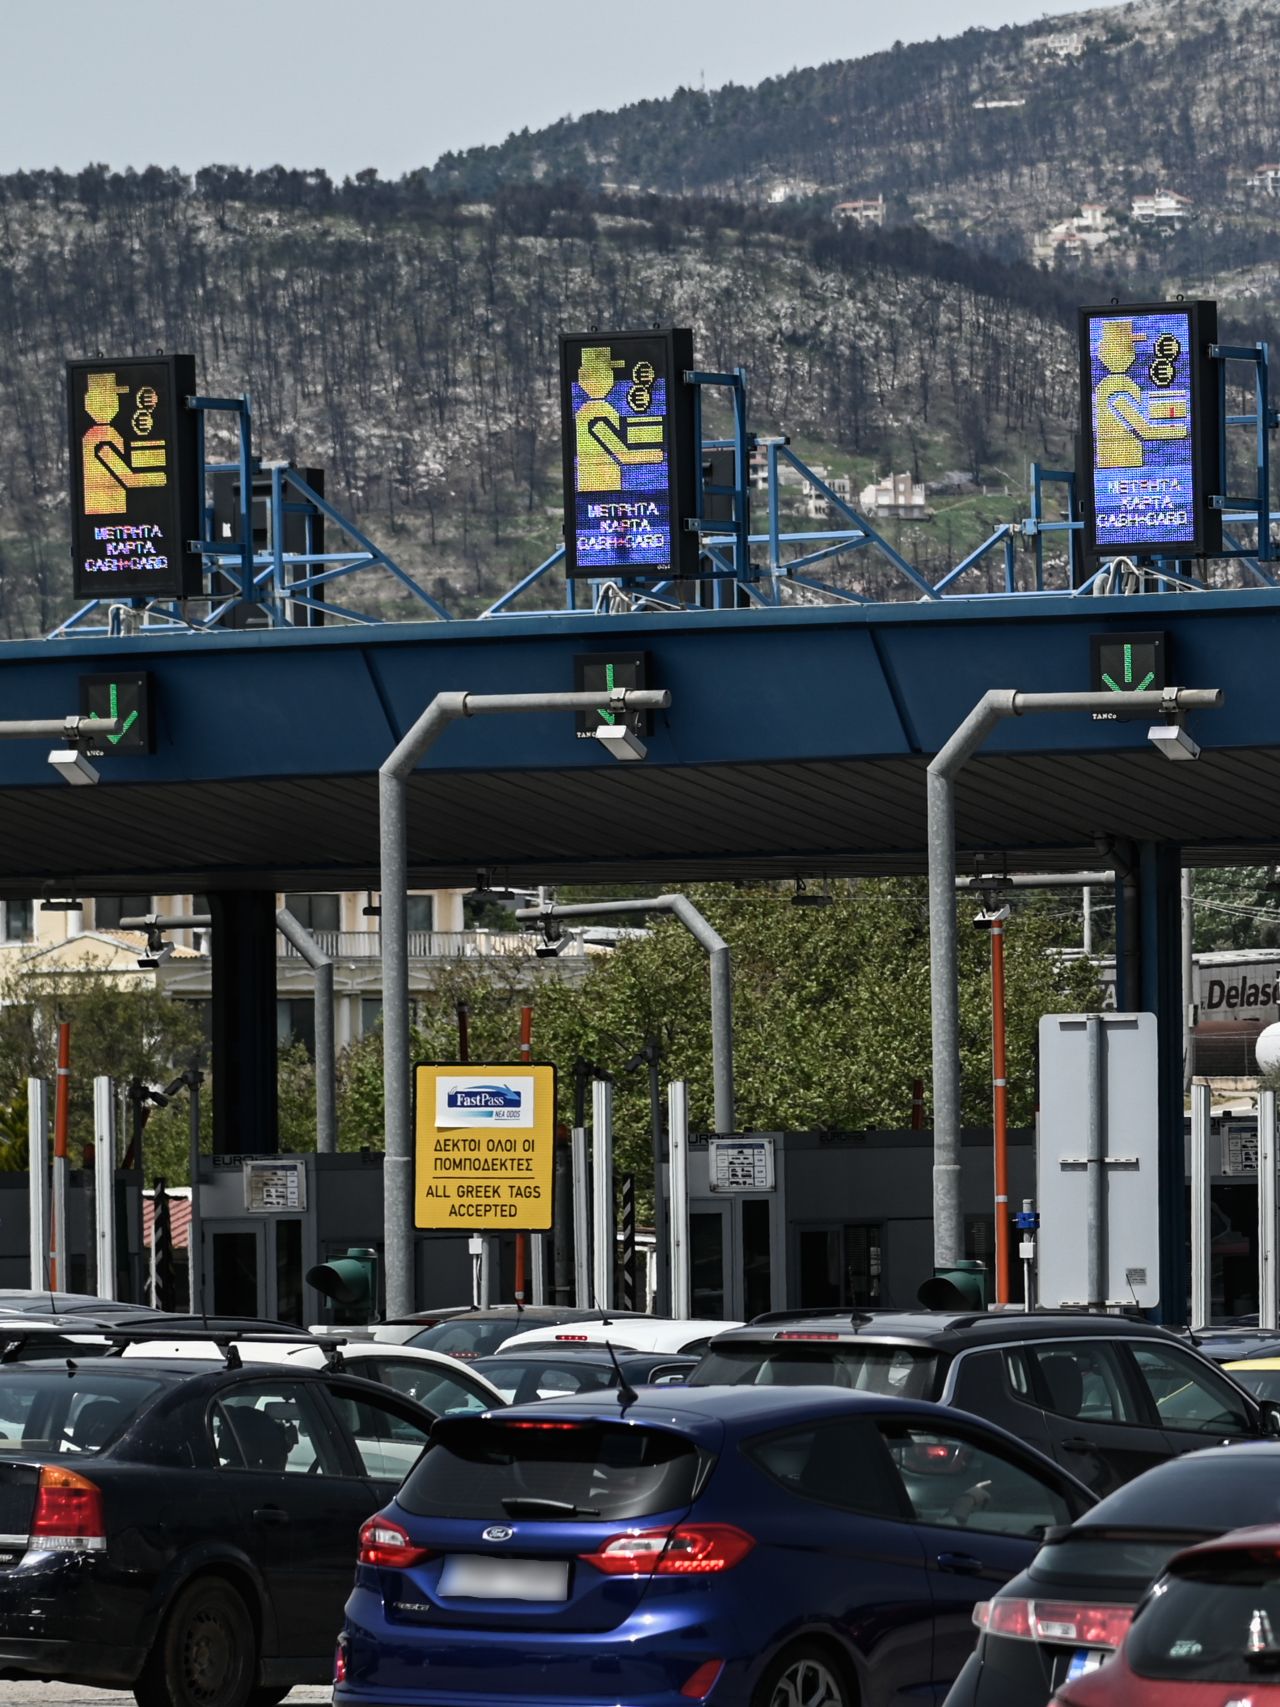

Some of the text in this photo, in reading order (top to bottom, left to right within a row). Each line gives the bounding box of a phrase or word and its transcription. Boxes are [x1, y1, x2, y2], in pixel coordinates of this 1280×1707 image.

[456, 1093, 505, 1106] FastPass
[434, 1139, 535, 1152] ΔΕΚΤΟΙ ΟΛΟΙ ΟΙ
[434, 1158, 533, 1171] ΠΟΜΠΟΔΕΚΤΕΣ
[426, 1185, 541, 1198] ALL GREEK TAGS
[449, 1204, 518, 1217] ACCEPTED
